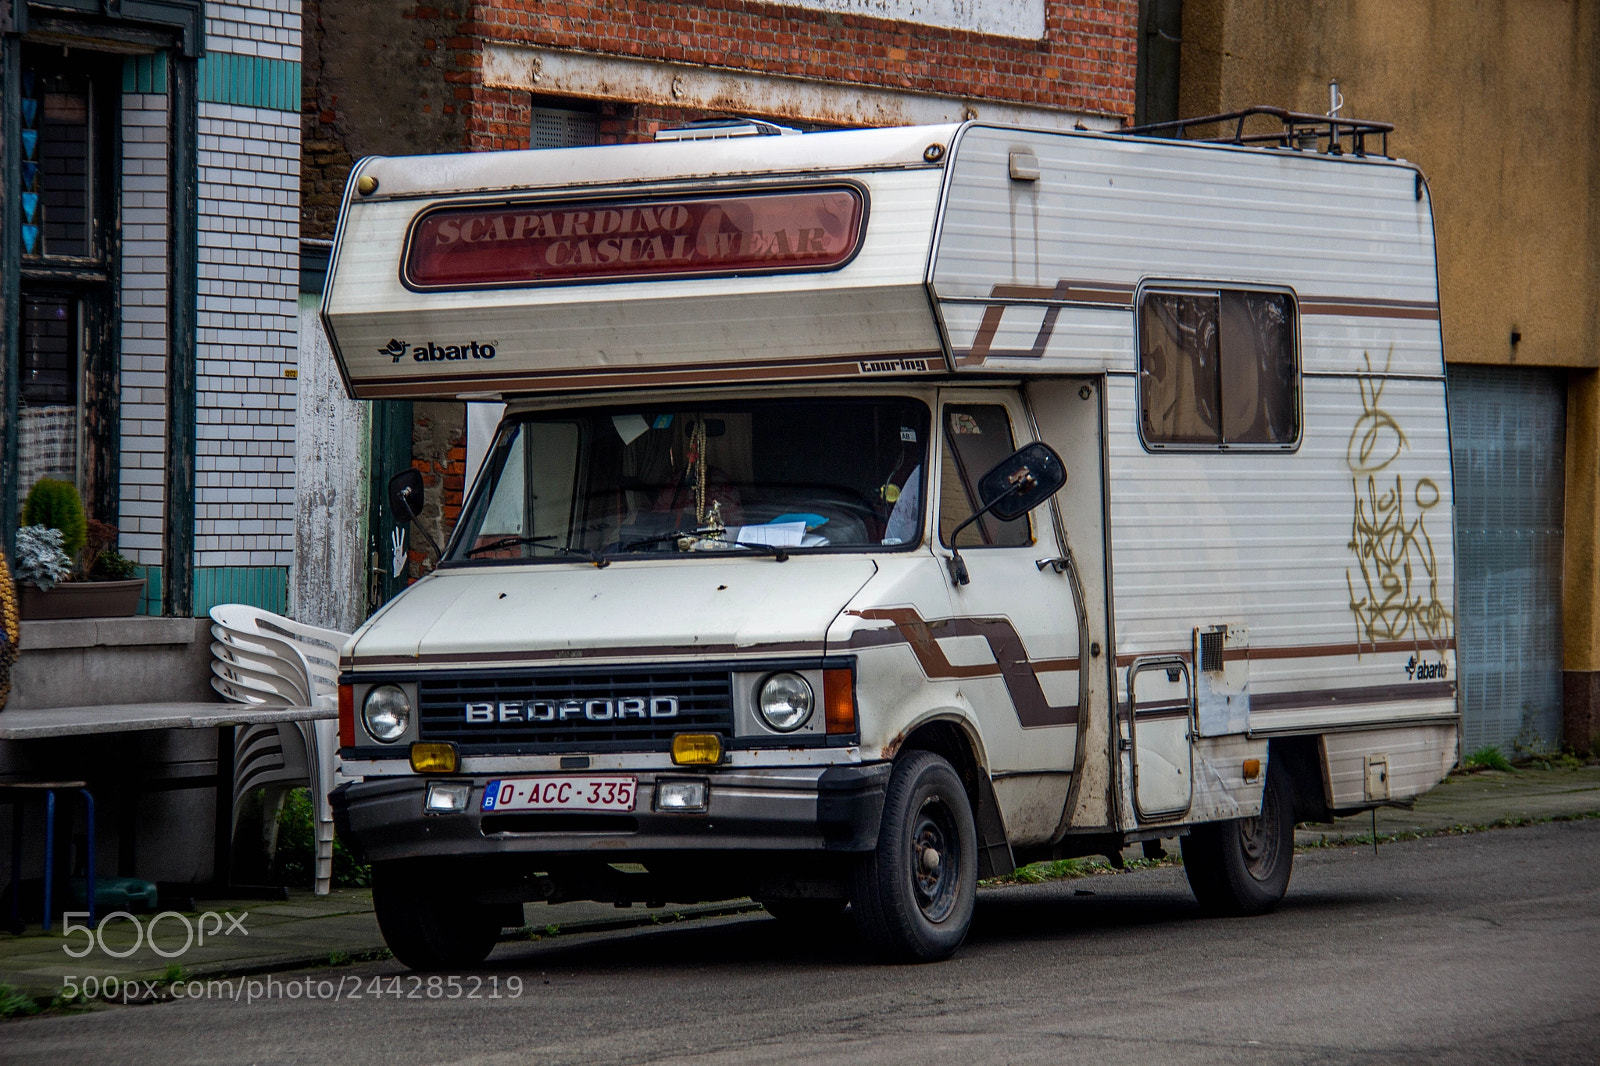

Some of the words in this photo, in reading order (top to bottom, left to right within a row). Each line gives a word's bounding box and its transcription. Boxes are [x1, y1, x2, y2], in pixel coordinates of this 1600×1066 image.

[436, 205, 688, 246] SCAPARDINO
[545, 235, 697, 267] CASUAL
[704, 227, 828, 261] WEAR
[413, 341, 496, 362] abarto
[860, 359, 927, 373] touring
[1417, 660, 1448, 680] abarto
[465, 697, 679, 723] BEDFORD
[484, 797, 493, 806] B
